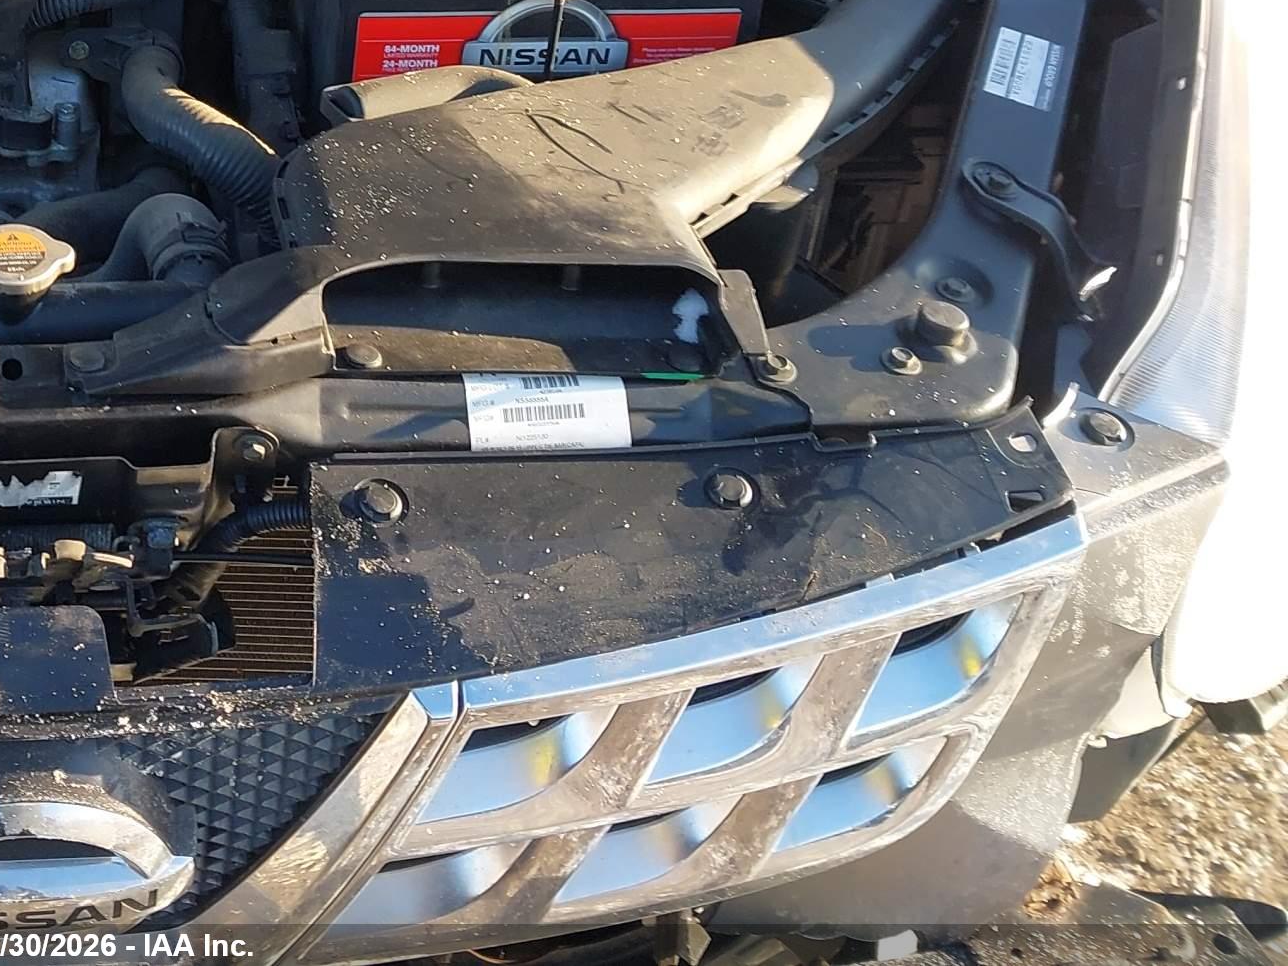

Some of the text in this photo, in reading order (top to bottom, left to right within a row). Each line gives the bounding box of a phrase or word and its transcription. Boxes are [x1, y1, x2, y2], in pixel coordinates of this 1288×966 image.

[383, 44, 441, 53] 84-MONTH
[479, 48, 611, 66] NISSAN
[382, 59, 439, 68] 24-MONTH
